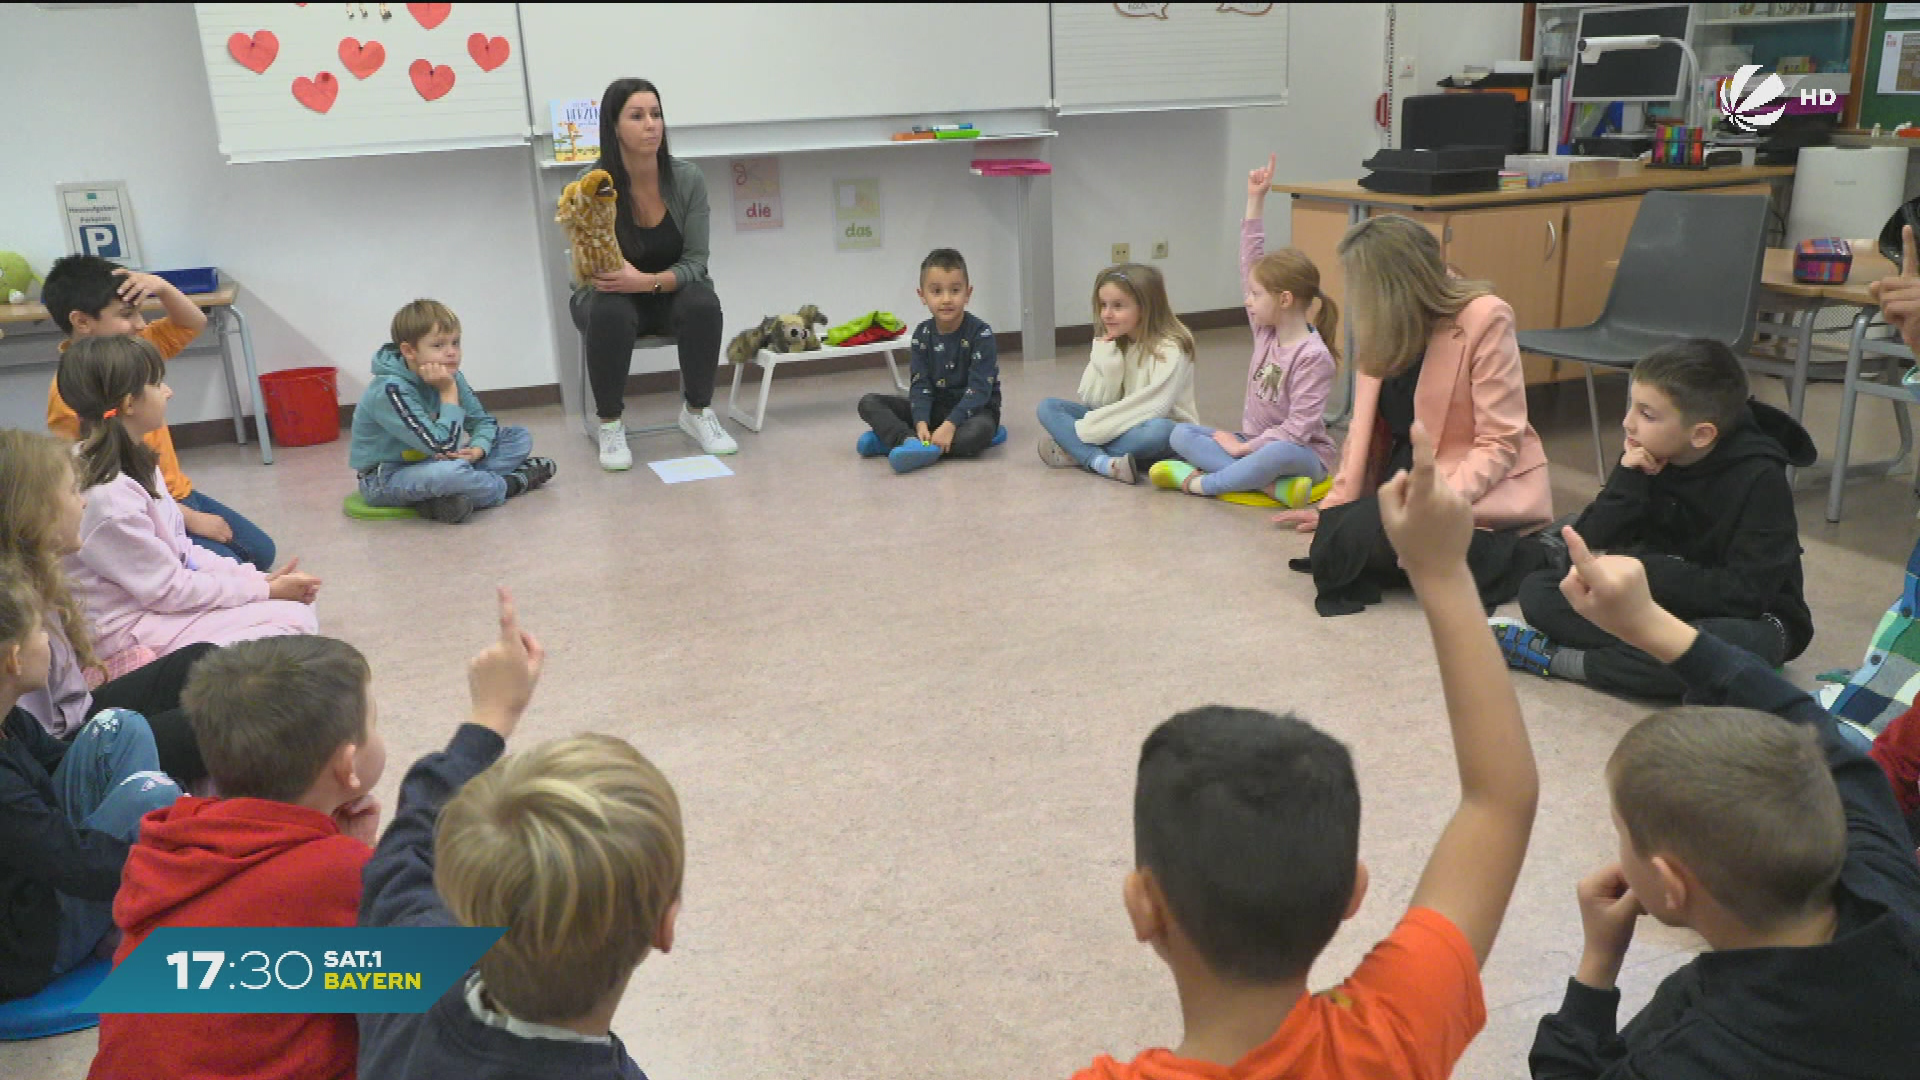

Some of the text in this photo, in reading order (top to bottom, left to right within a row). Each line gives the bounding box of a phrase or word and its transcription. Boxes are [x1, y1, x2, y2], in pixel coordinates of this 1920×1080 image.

[746, 203, 771, 218] die
[845, 223, 873, 238] das
[86, 228, 113, 256] P
